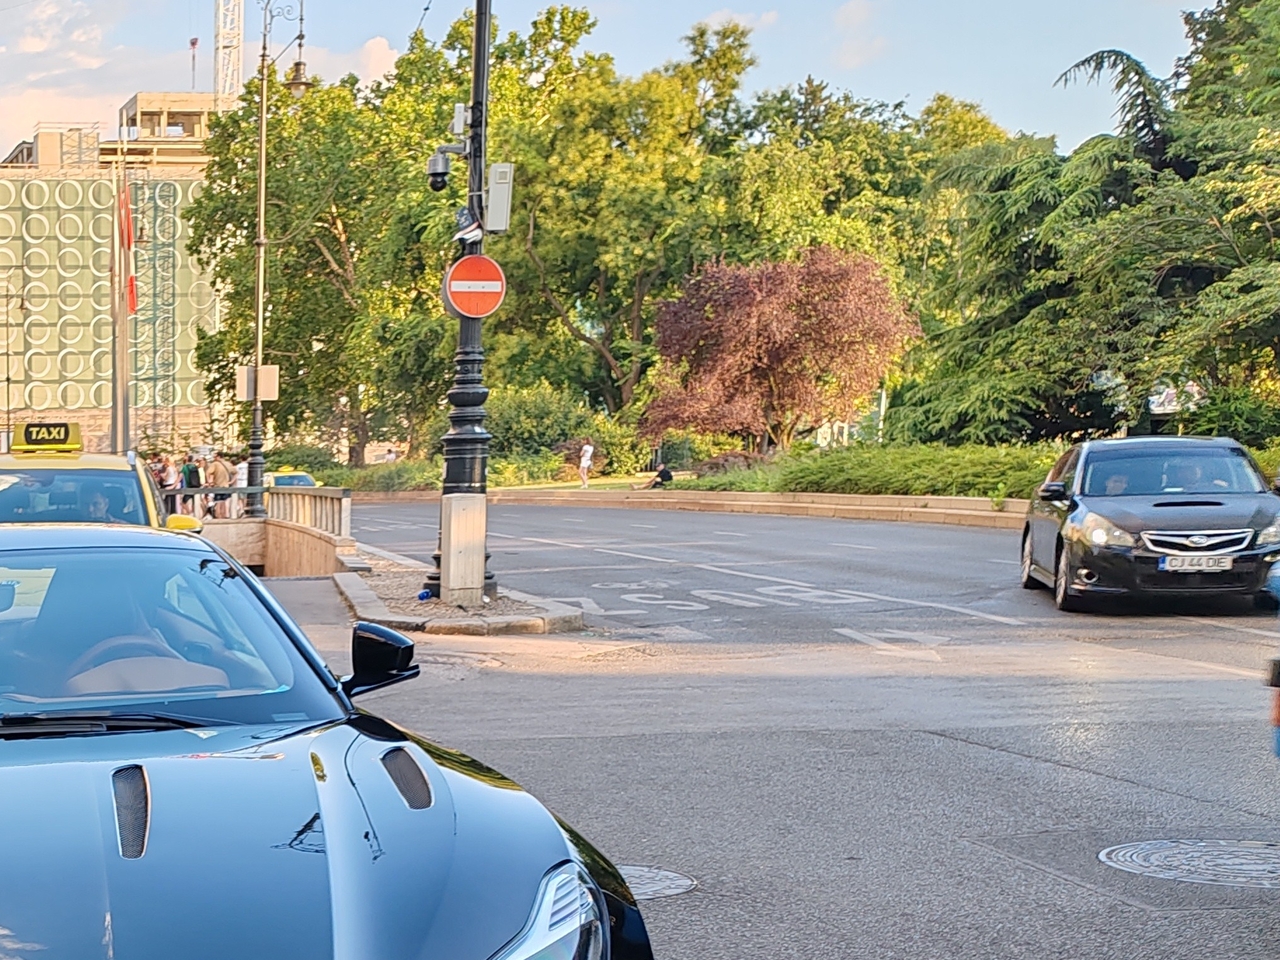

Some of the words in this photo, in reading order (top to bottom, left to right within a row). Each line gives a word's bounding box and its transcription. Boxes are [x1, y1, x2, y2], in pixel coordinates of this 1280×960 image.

[29, 427, 65, 440] TAXI
[1169, 557, 1185, 568] CJ
[1188, 557, 1203, 567] 44
